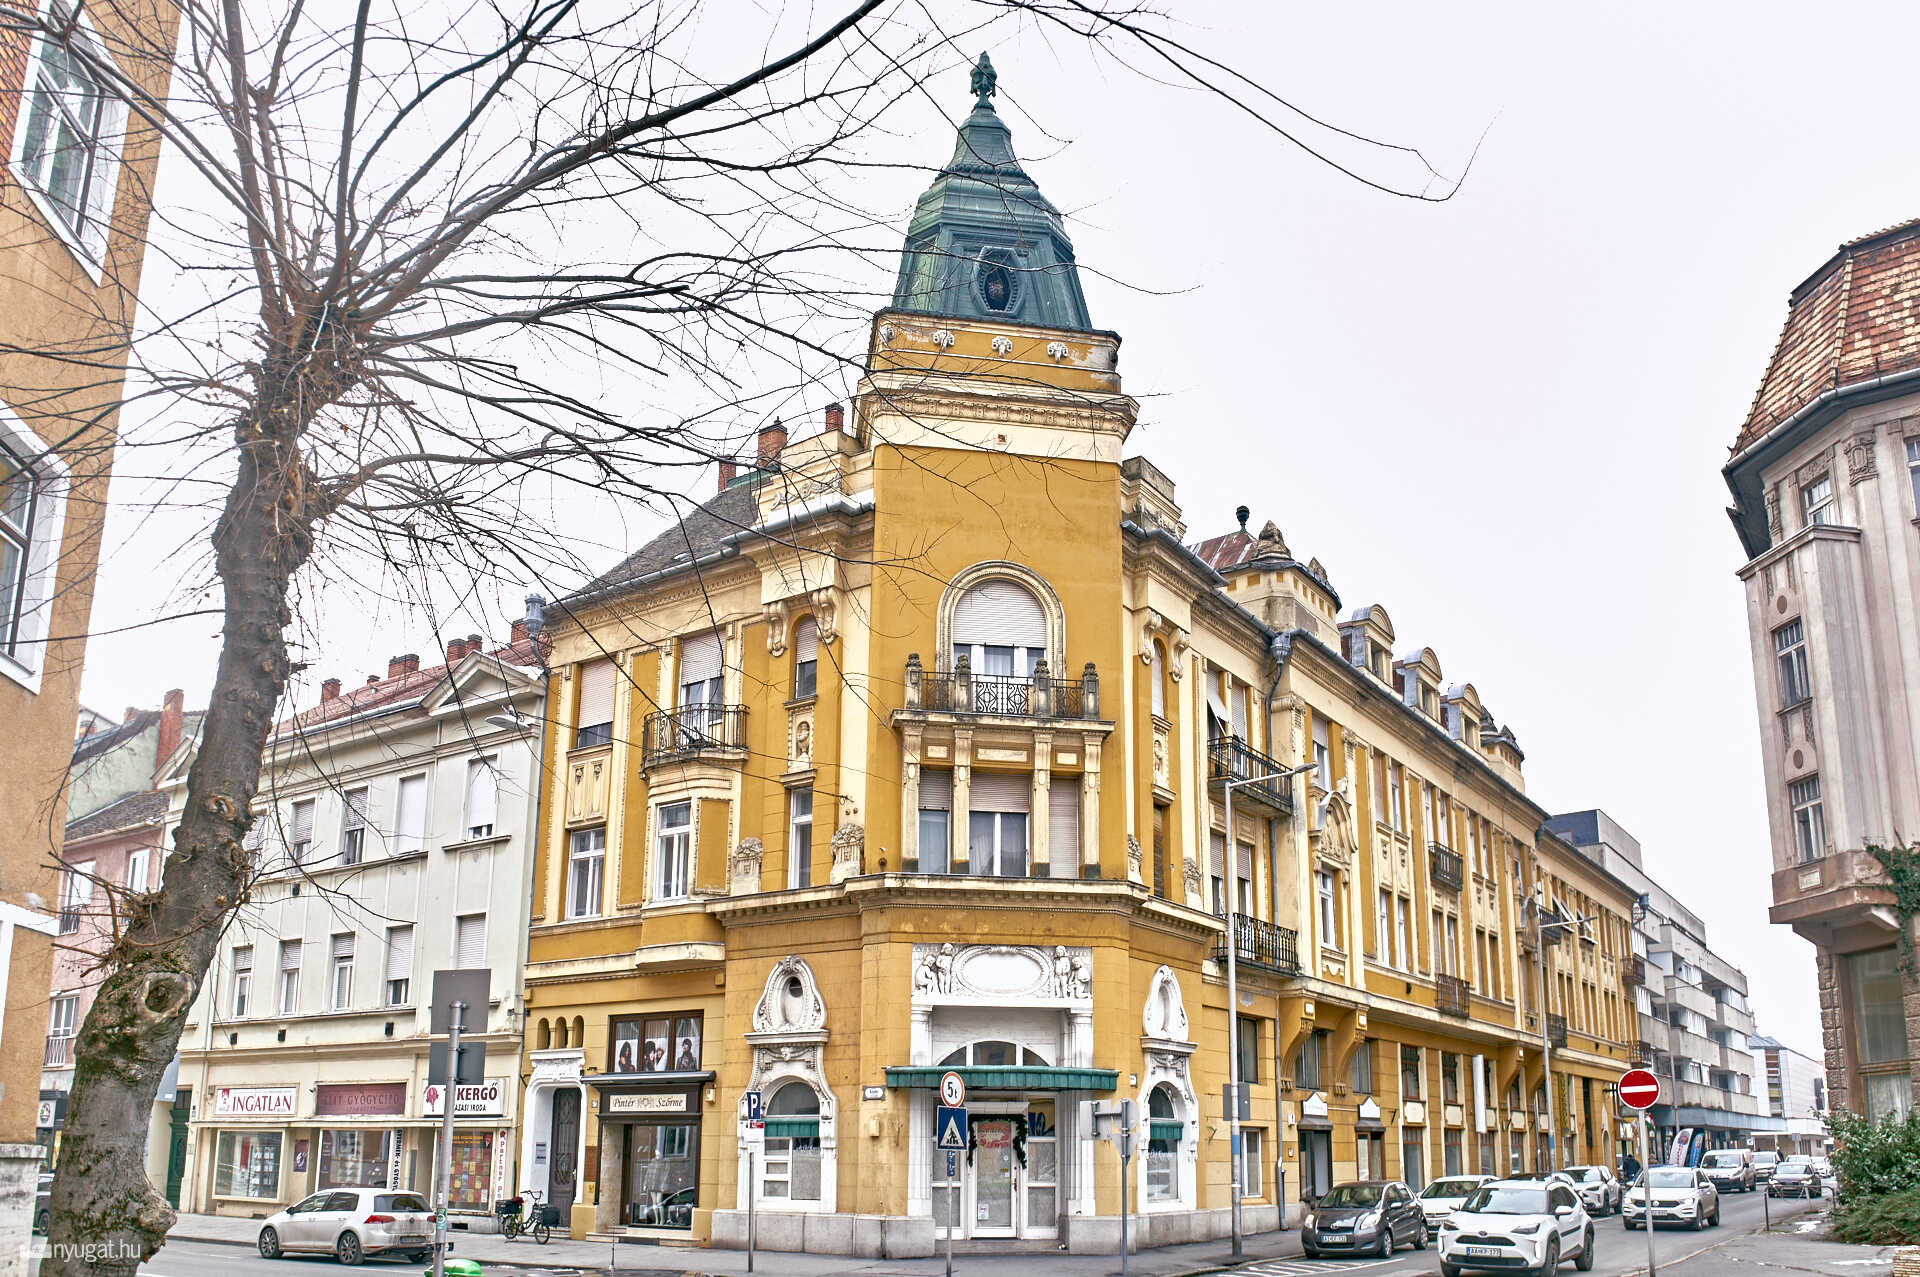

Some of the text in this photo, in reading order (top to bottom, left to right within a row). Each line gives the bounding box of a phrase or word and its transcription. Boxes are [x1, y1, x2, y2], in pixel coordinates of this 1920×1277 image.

[443, 1082, 498, 1101] KERGŐ
[232, 1095, 292, 1112] INGATLAN
[750, 1094, 759, 1118] P
